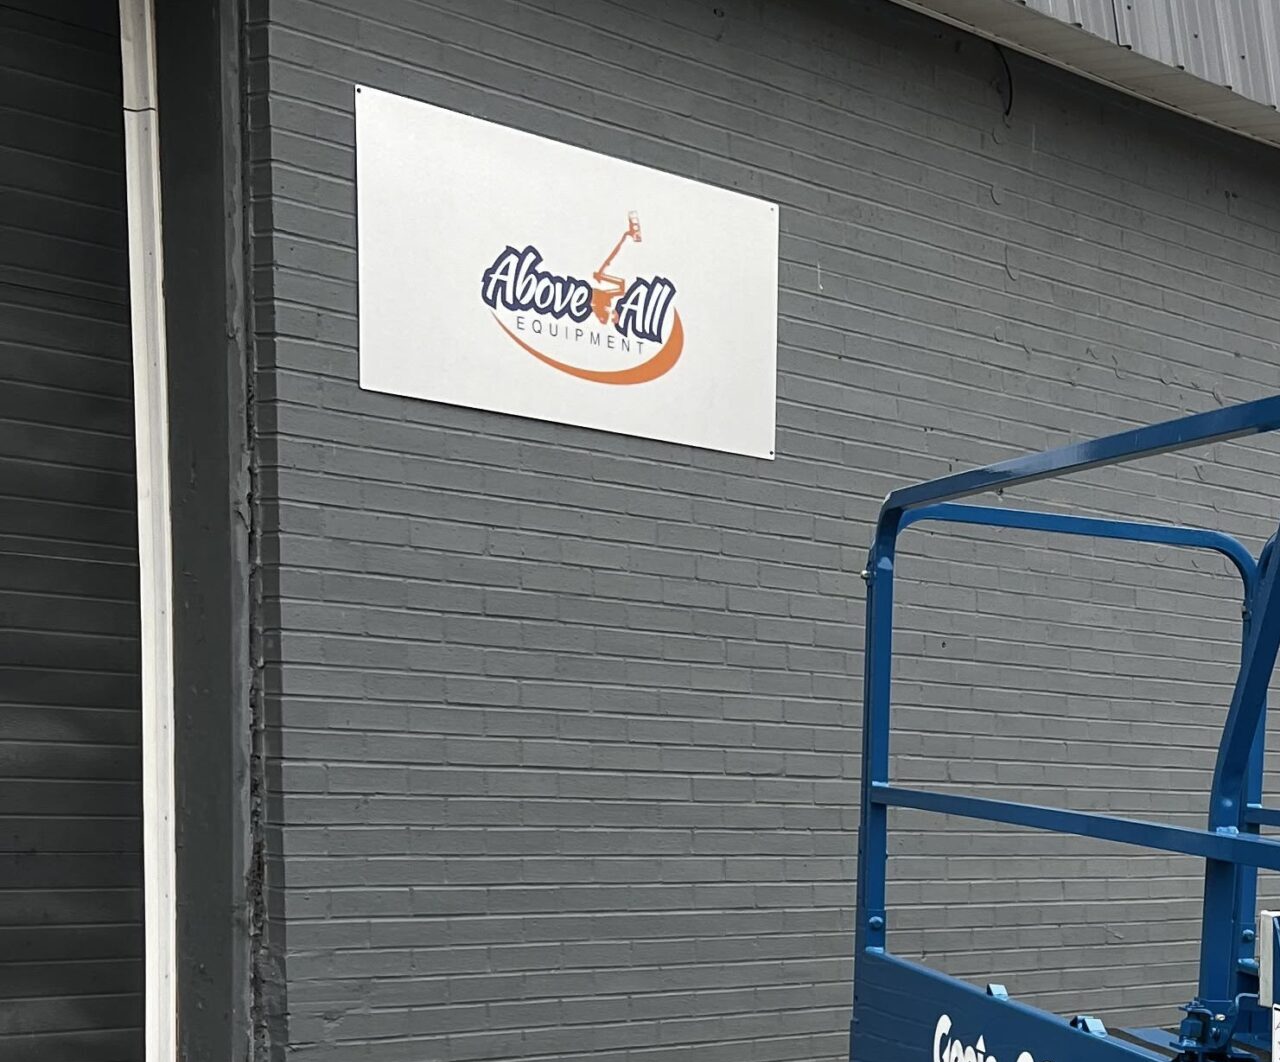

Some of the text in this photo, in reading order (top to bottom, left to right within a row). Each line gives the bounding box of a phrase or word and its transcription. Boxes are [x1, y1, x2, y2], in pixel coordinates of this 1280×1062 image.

[483, 246, 676, 343] Above All
[516, 316, 645, 355] EQUIPMENT
